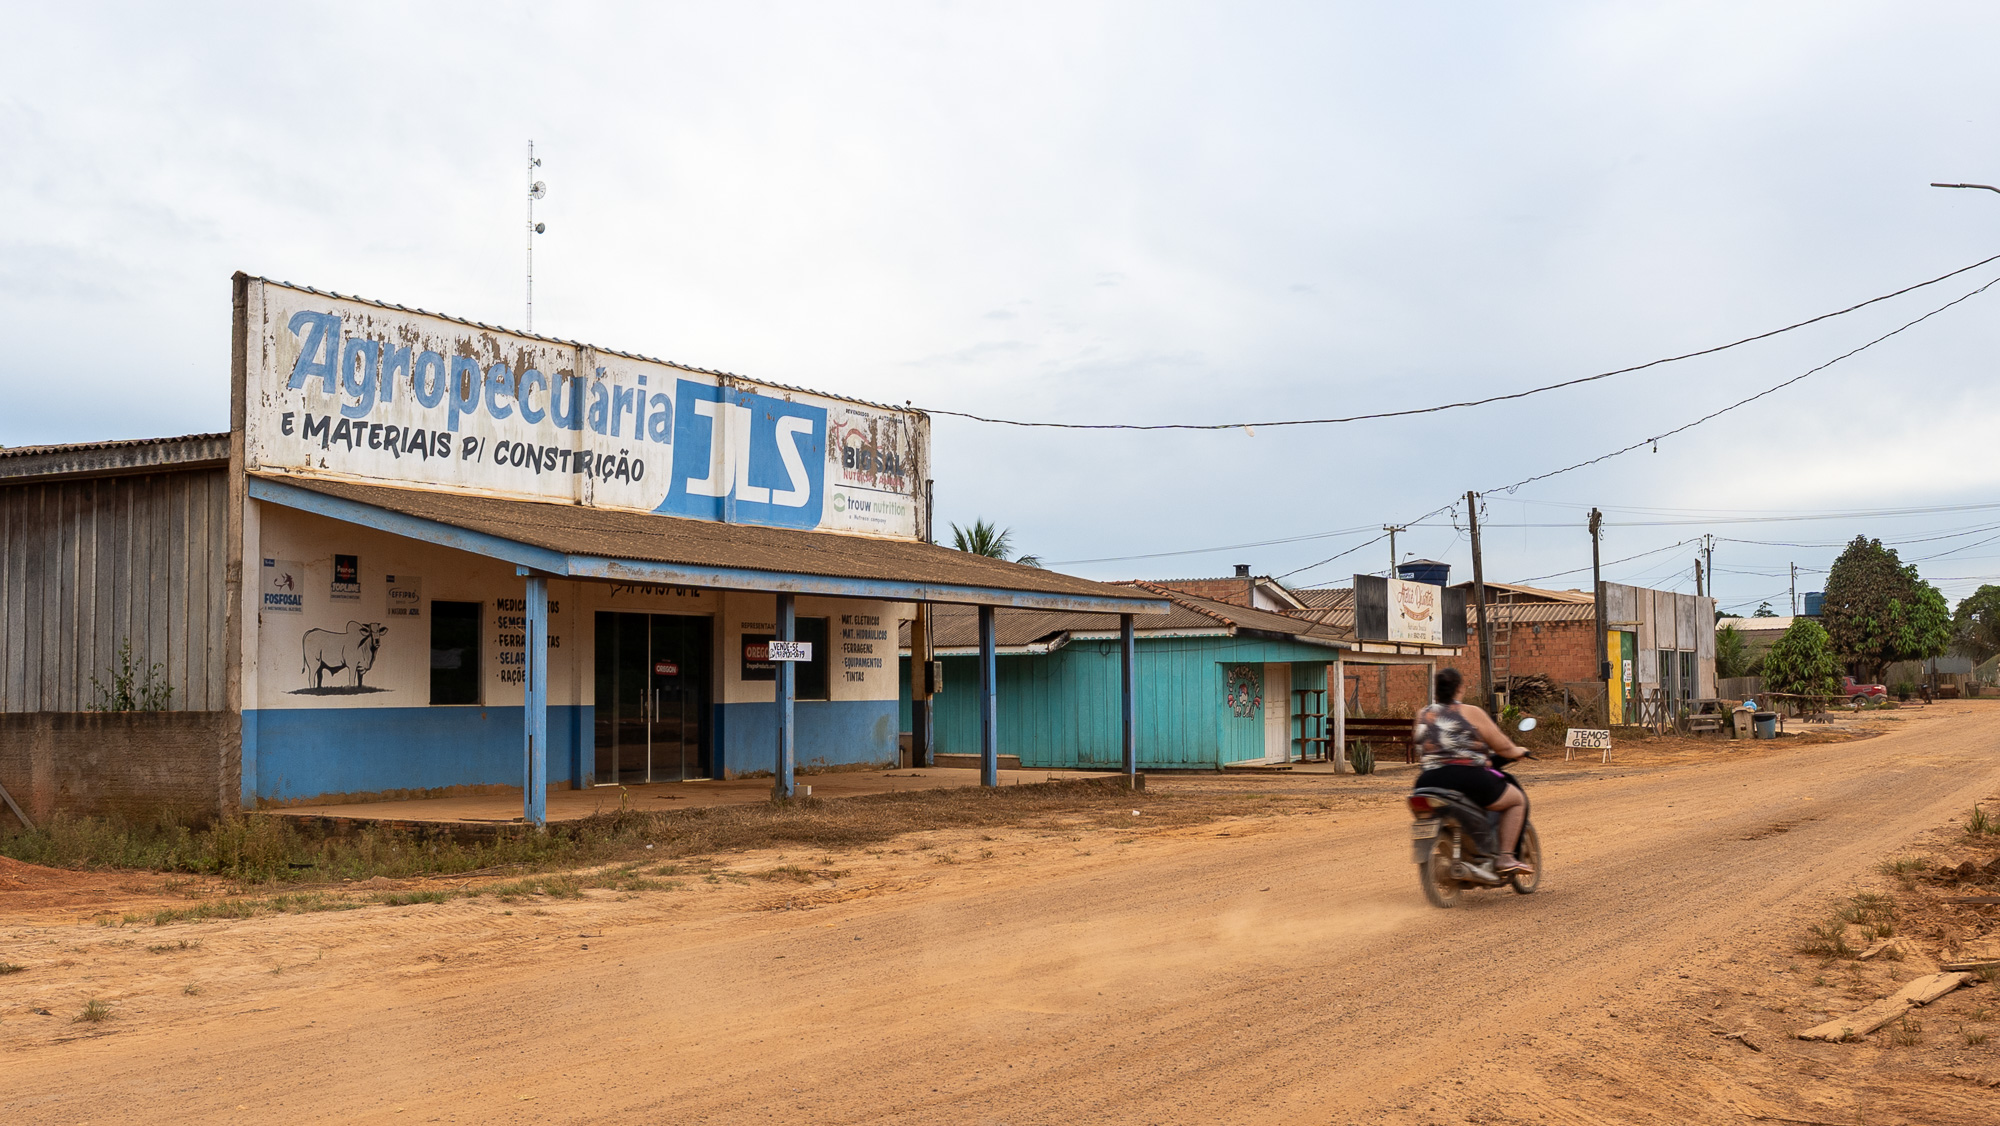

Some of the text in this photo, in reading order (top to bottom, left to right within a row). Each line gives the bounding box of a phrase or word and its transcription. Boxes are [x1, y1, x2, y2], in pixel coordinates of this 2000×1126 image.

[287, 309, 674, 446] Agropecuária
[281, 411, 295, 436] E
[302, 413, 452, 460] MATERIAIS
[462, 436, 486, 464] P/
[686, 398, 814, 508] JLS
[843, 446, 905, 478] BIG SAL
[848, 496, 906, 516] trouw nutrition
[331, 582, 361, 593] TOPLINE
[264, 593, 302, 606] FOSFOSAL
[391, 591, 416, 599] EFFIPRO
[497, 598, 560, 614] MEDICATOS
[841, 614, 853, 625] MAT.
[842, 628, 855, 640] MAT.
[499, 634, 560, 648] FERRATAS
[773, 642, 799, 652] VENDE-SE
[746, 646, 768, 658] OREGO
[843, 642, 873, 654] FERRAGENS
[844, 657, 882, 669] EQUIPAMENTOS
[501, 666, 526, 686] RAÇÕE
[846, 671, 865, 682] TINTAS
[1573, 730, 1609, 740] TEMOS
[1572, 738, 1601, 748] GELO
